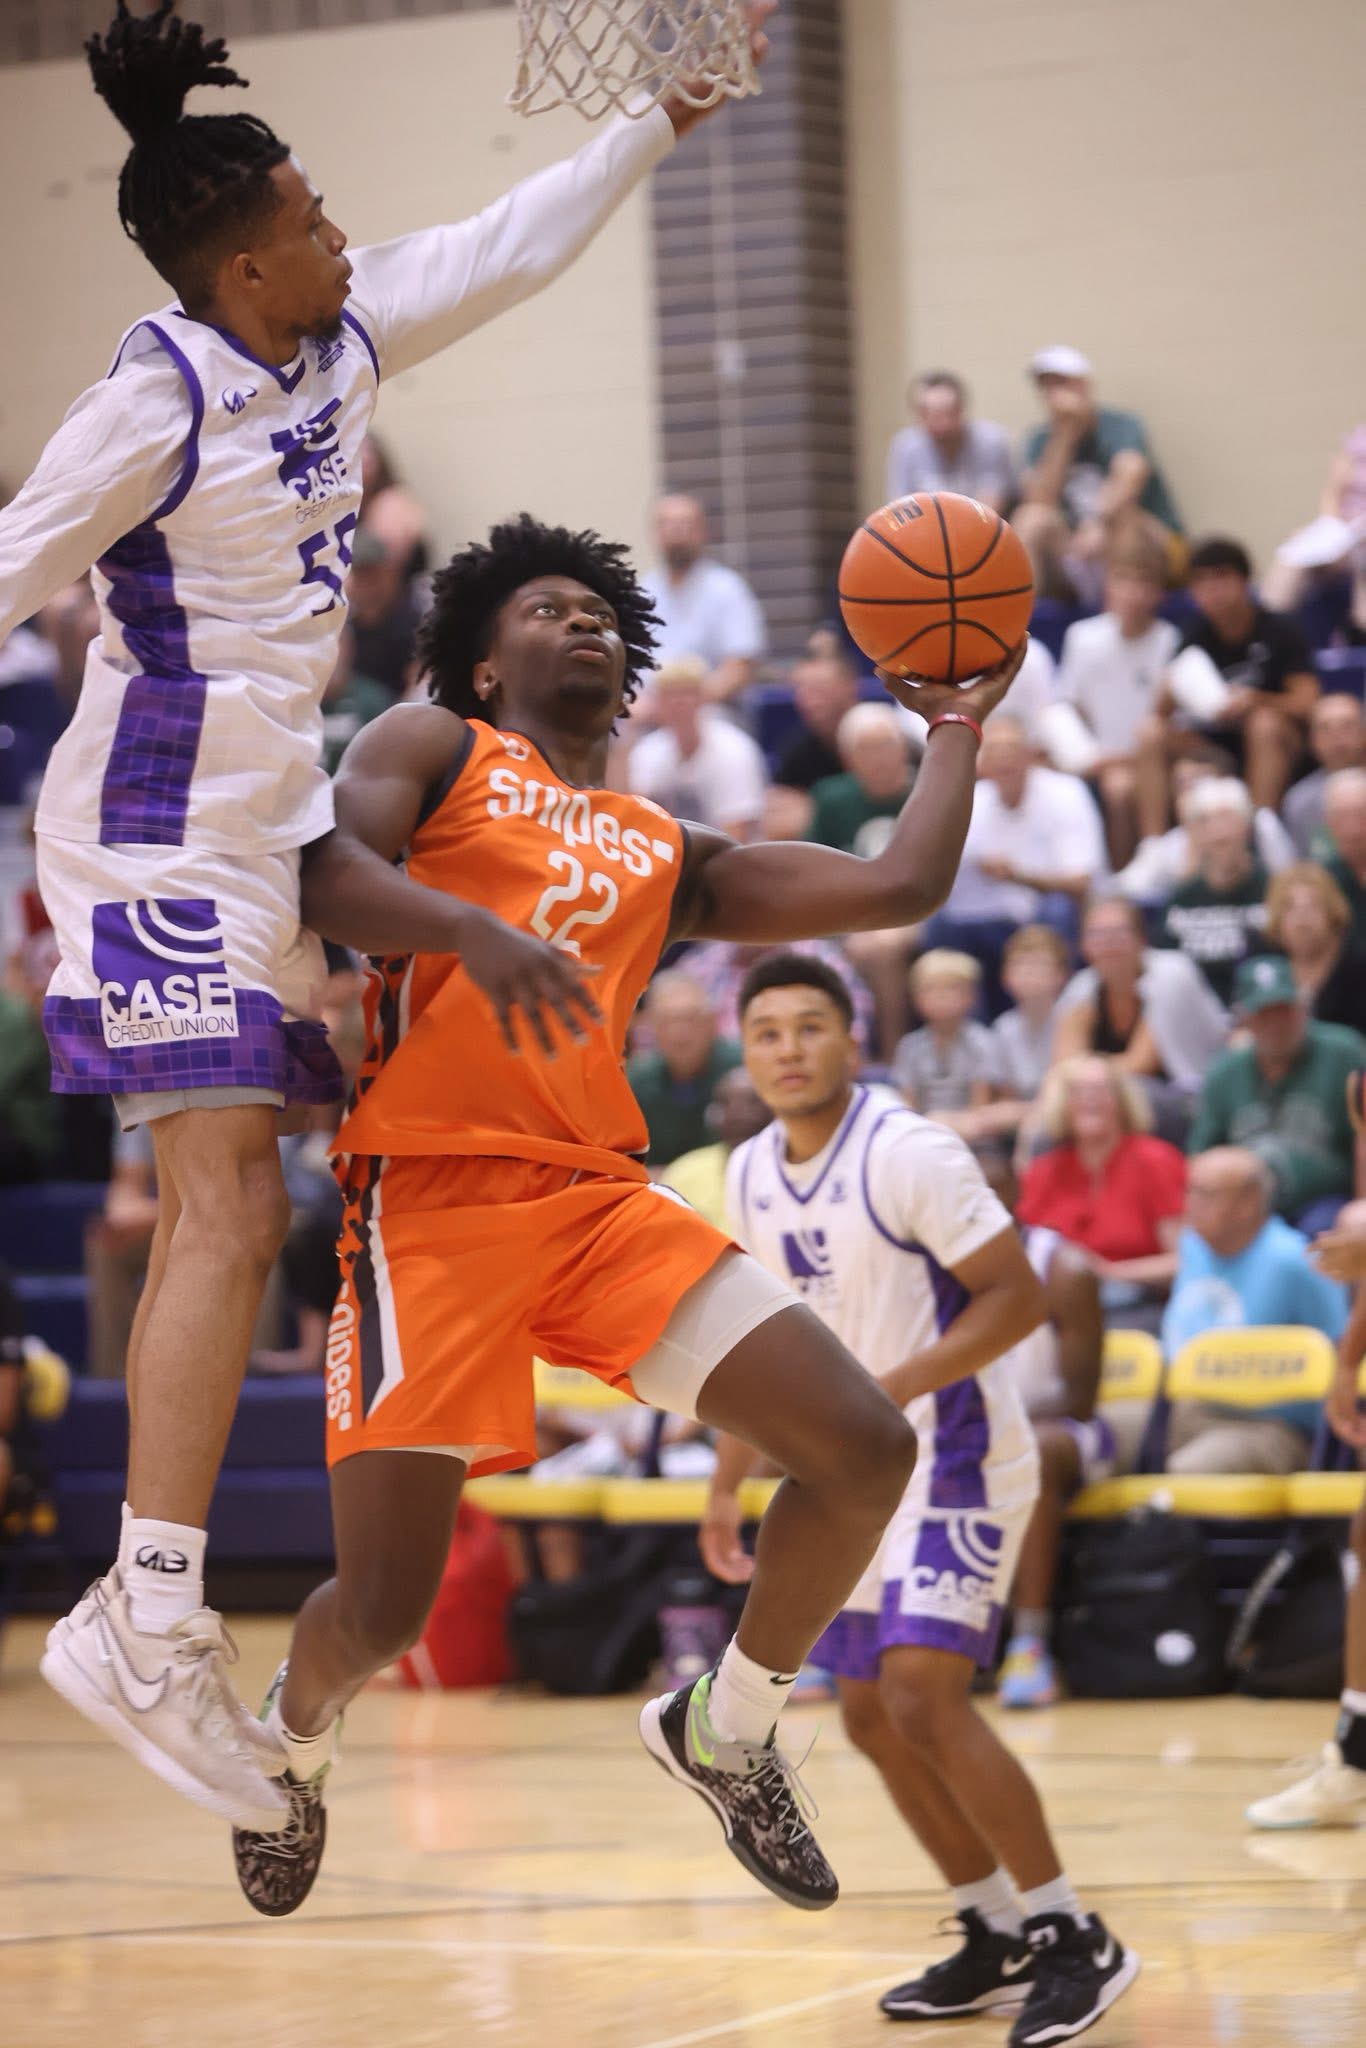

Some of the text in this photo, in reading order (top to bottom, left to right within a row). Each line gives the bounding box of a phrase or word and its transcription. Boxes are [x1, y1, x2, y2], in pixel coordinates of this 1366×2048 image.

[529, 850, 619, 959] 22
[101, 973, 234, 1023] CASE
[109, 1015, 235, 1044] CREDIT UNION
